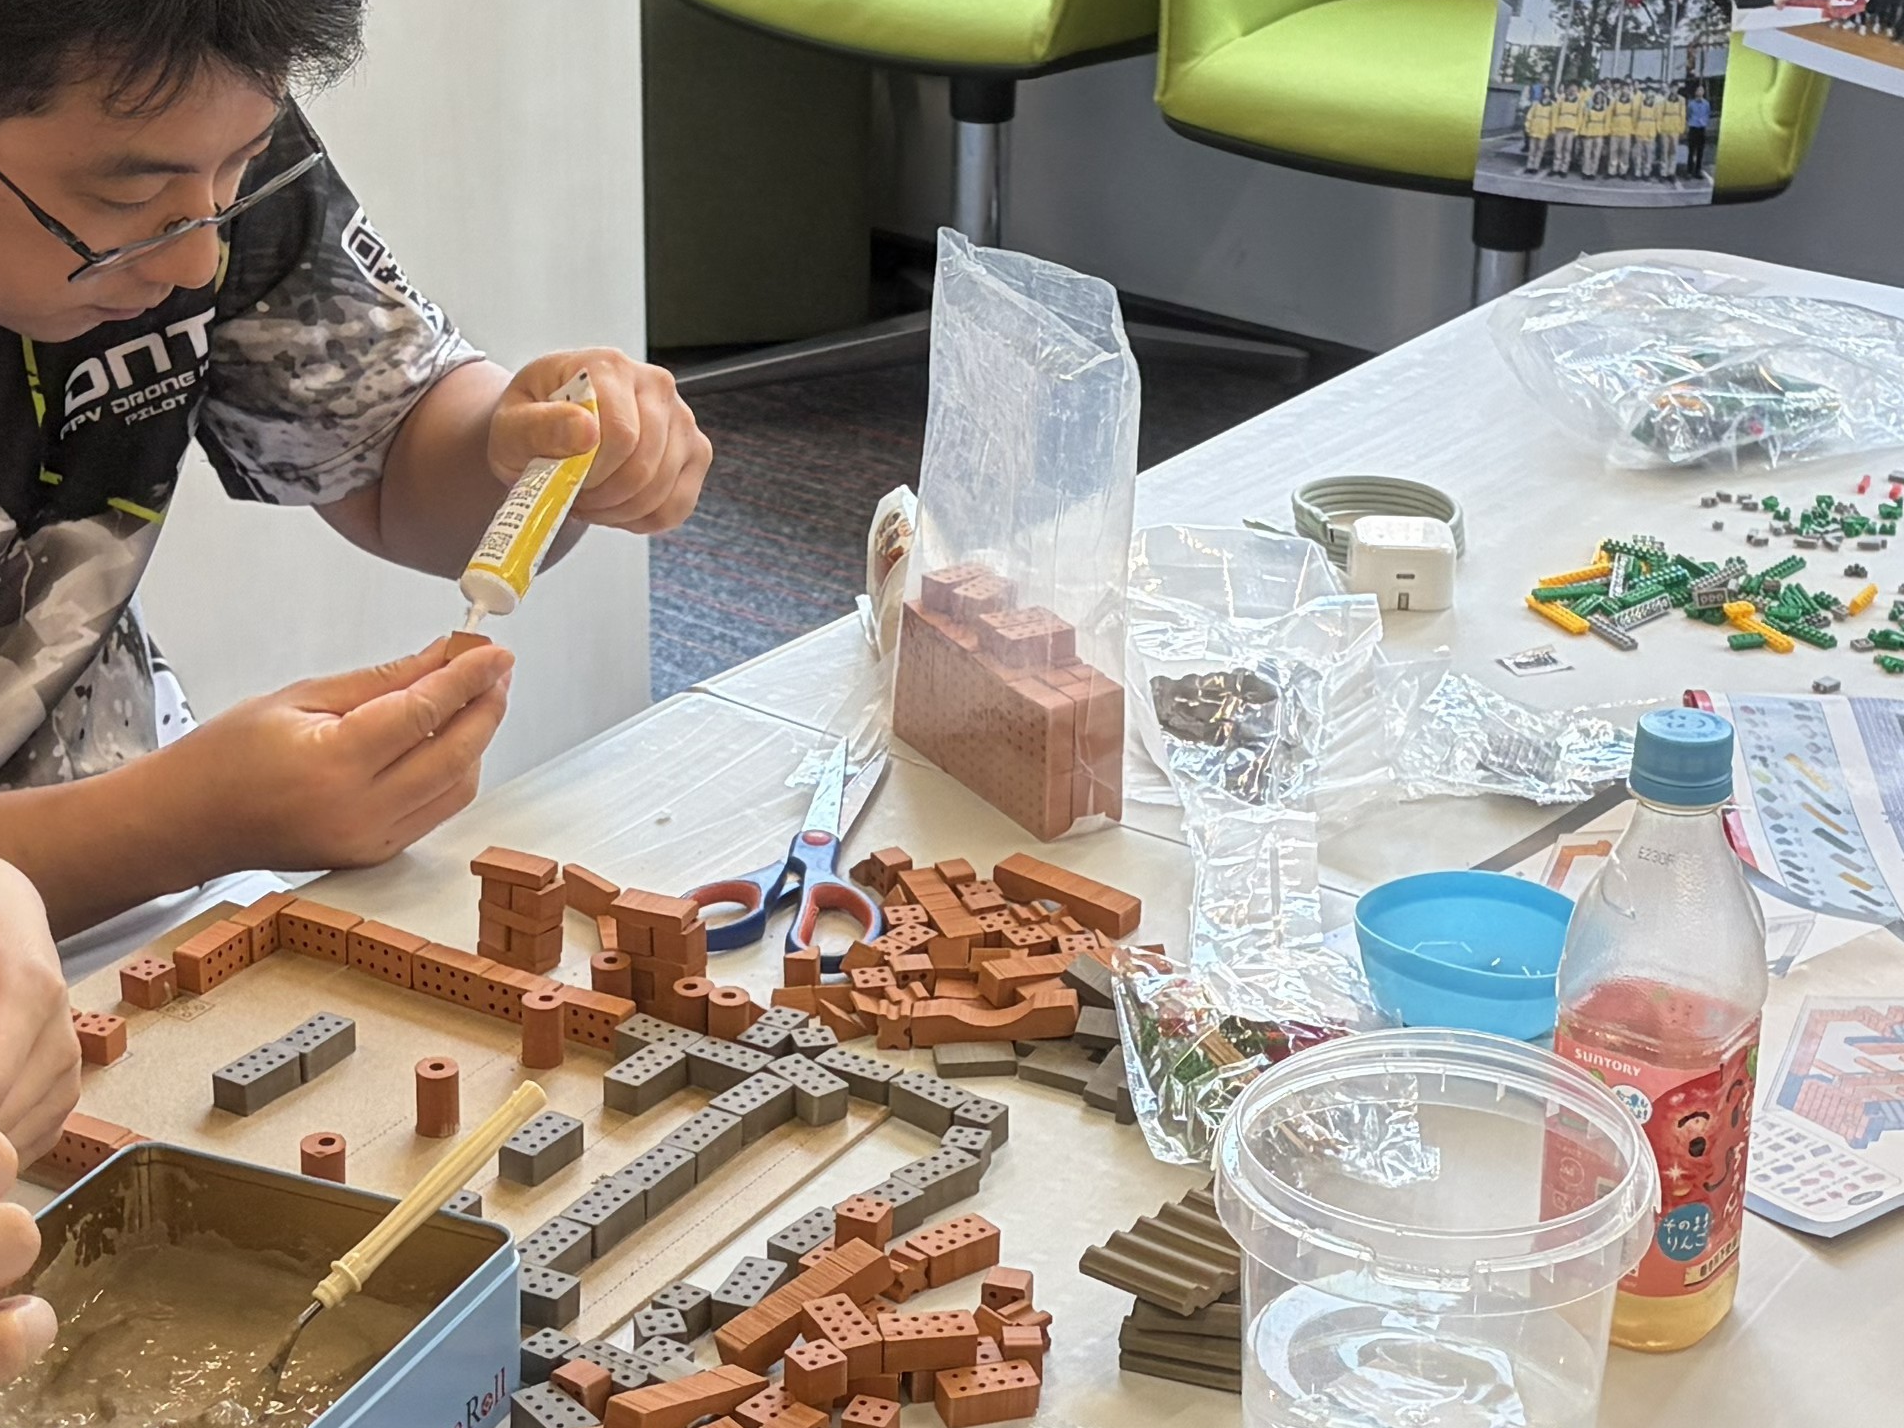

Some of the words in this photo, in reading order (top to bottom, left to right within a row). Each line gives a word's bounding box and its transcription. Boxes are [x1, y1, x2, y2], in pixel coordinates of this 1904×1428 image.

[110, 370, 196, 414] DRONE
[124, 392, 188, 426] PILOT
[1574, 1047, 1643, 1078] SUNTORY
